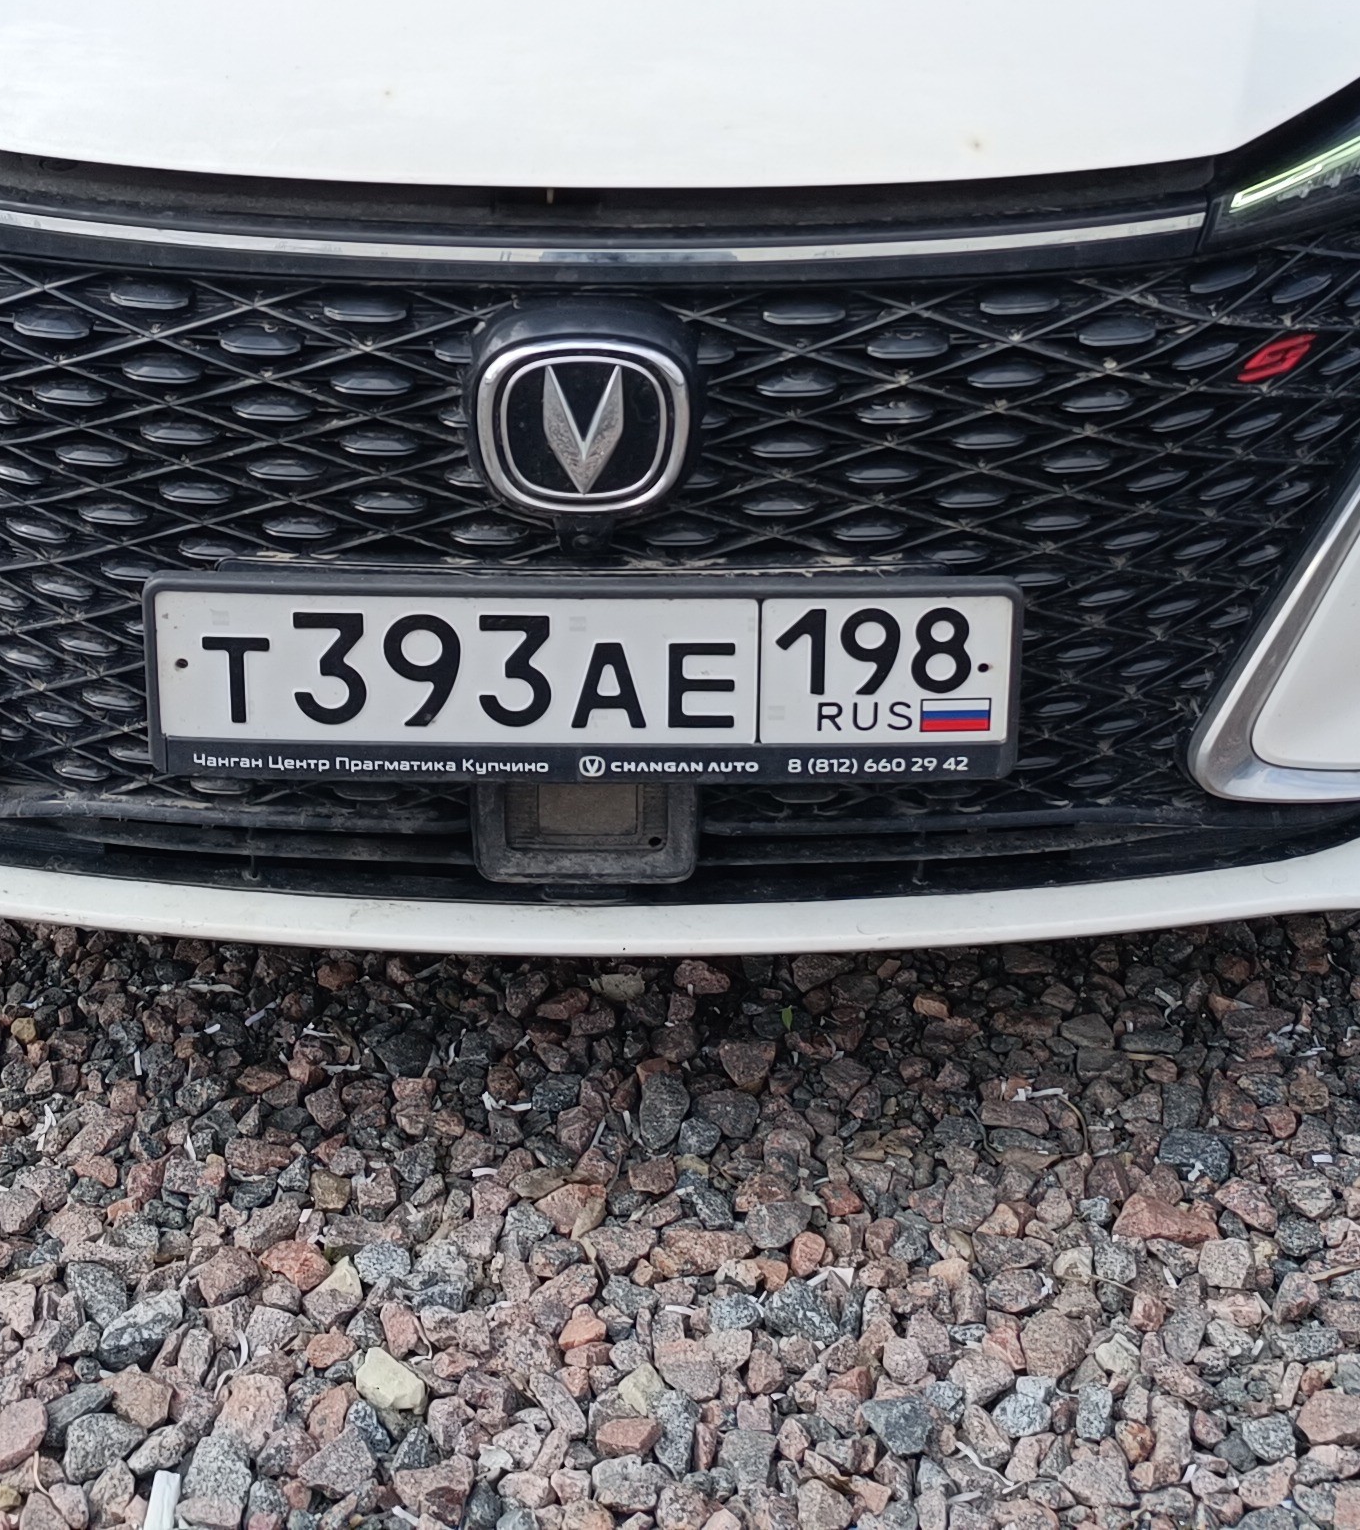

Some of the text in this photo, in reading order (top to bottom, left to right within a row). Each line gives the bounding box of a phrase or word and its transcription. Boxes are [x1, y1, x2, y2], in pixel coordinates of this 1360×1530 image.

[775, 607, 972, 696] 198
[817, 701, 913, 732] RUS
[193, 753, 549, 775] Чанган Центр Прагматика Купчино
[610, 761, 759, 772] CHANGAN AUTO
[787, 756, 969, 775] 8 (812) 660 29 42
